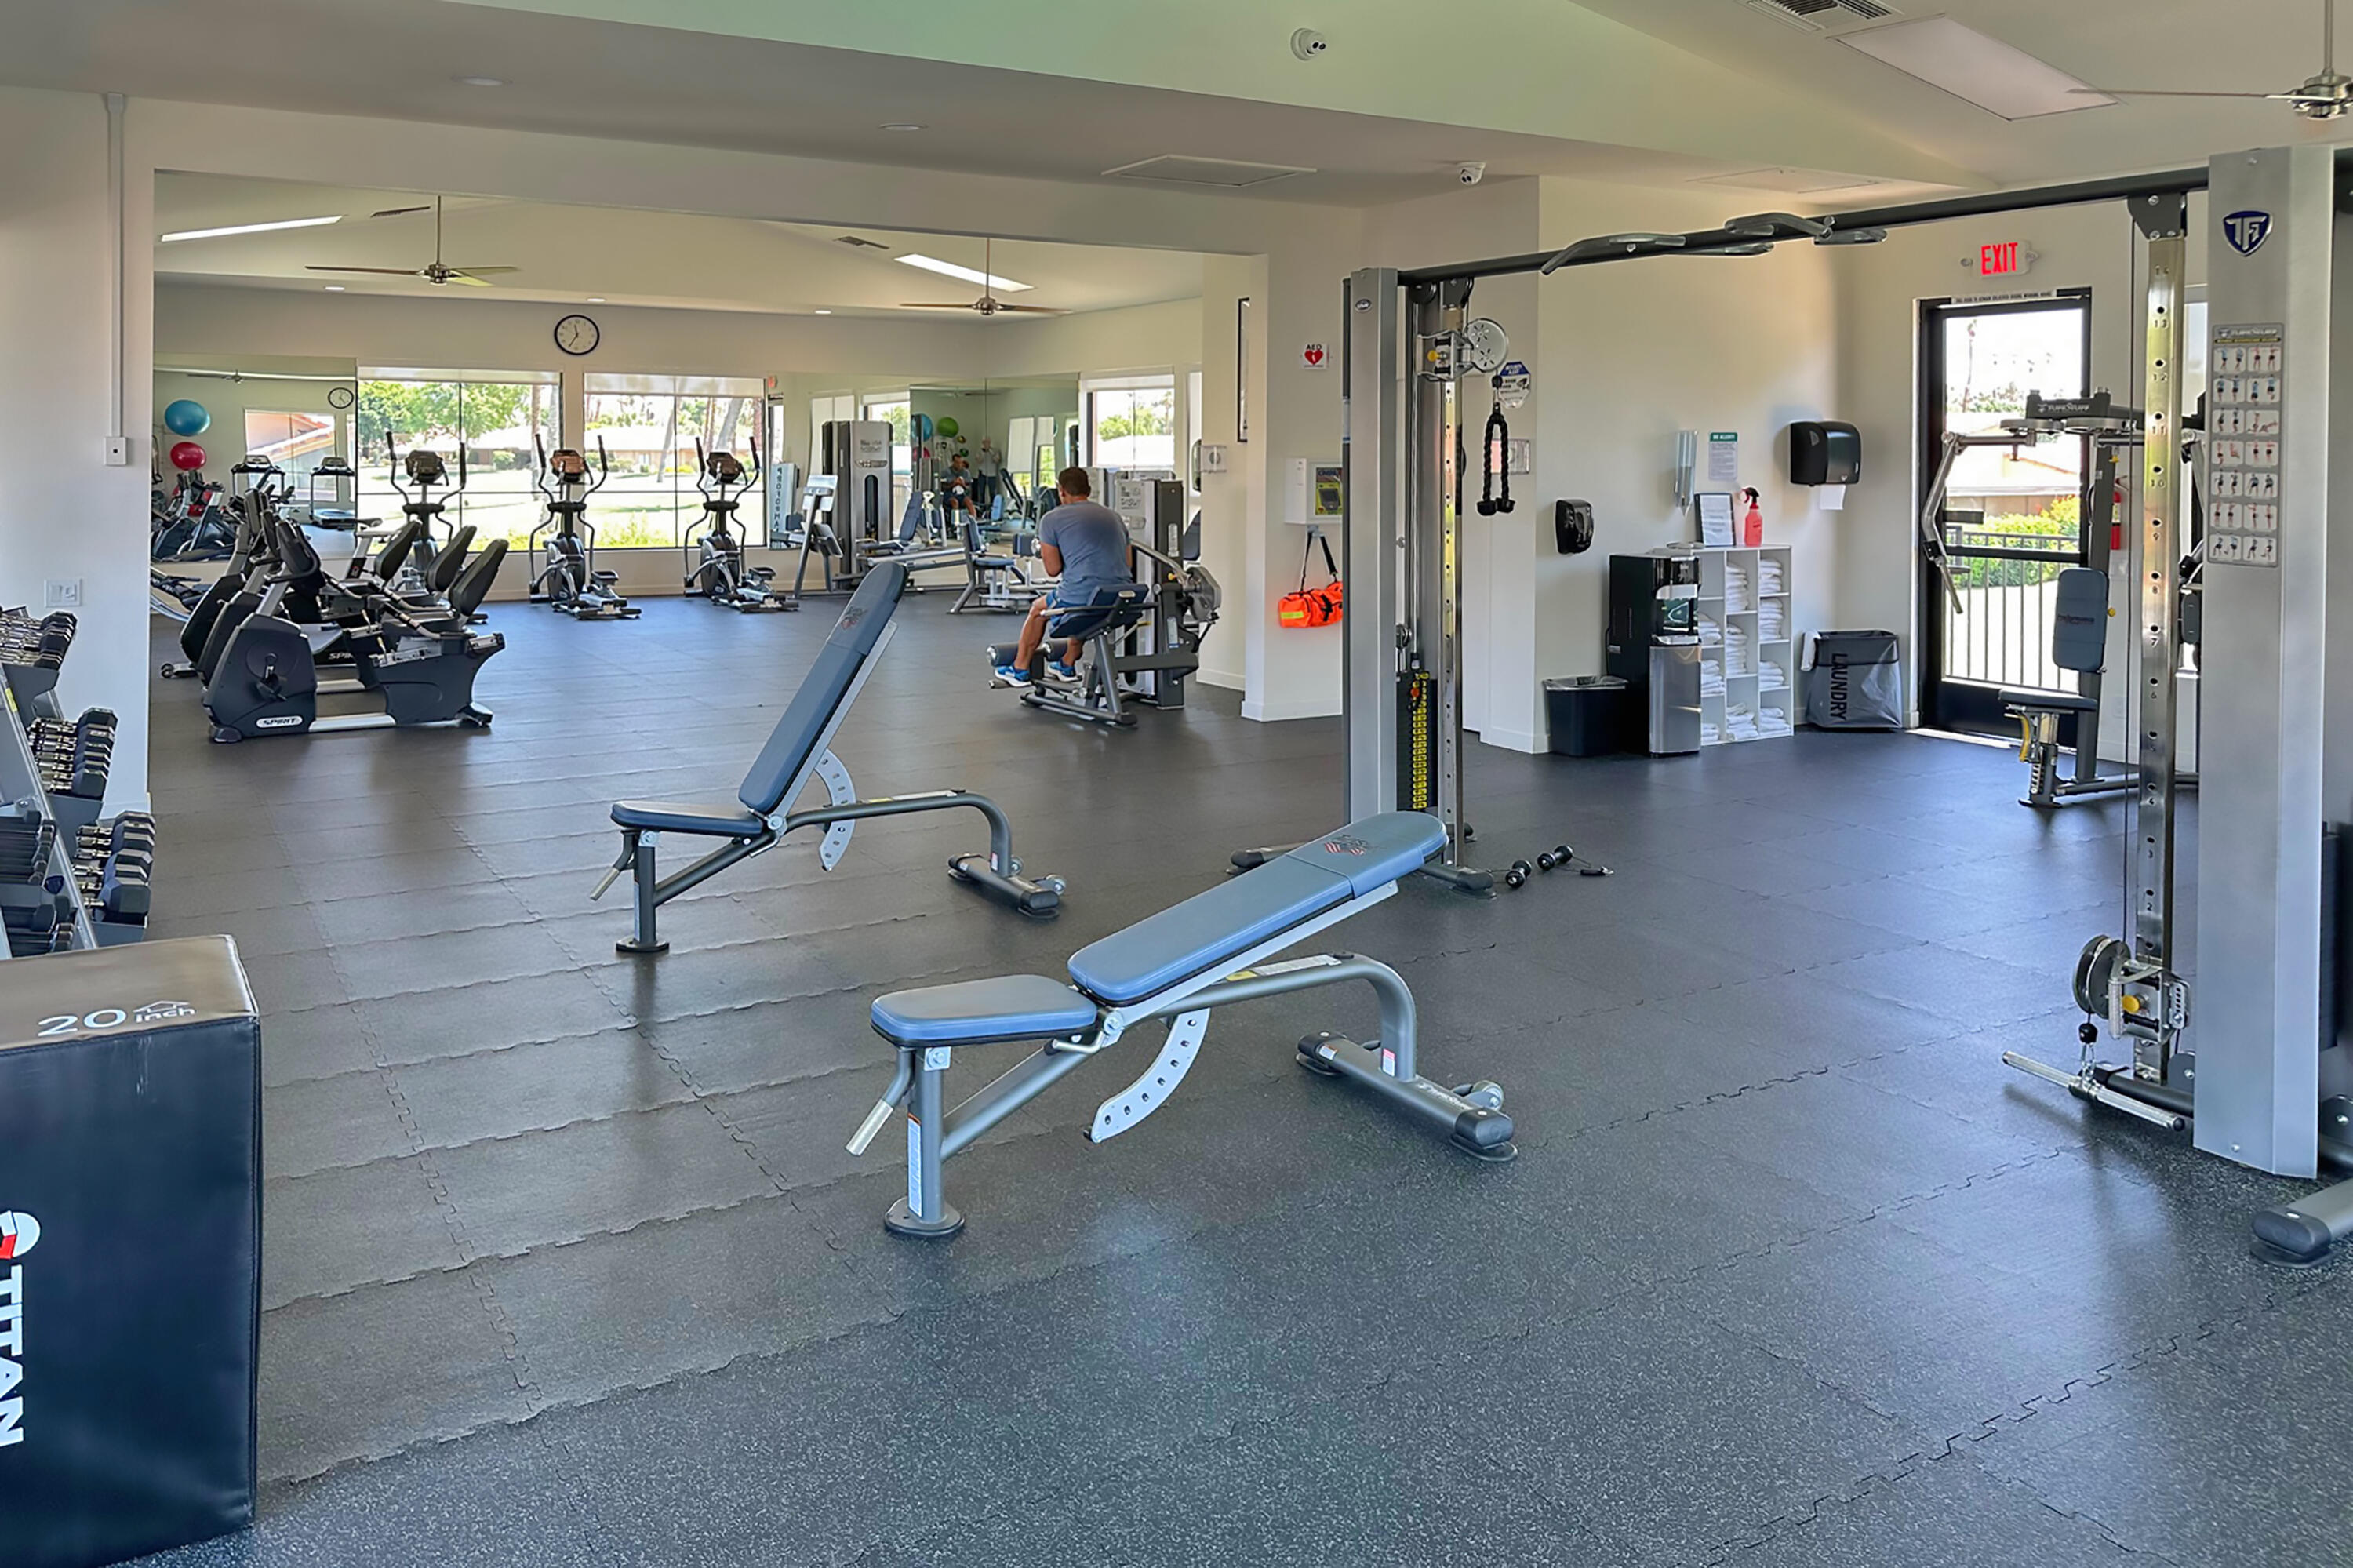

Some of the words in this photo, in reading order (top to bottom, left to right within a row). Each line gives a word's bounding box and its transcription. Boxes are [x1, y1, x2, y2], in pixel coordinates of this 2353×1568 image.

[1980, 242, 2019, 275] EXIT
[2154, 319, 2168, 329] 13
[2152, 373, 2167, 382] 12
[2151, 426, 2166, 435] 11
[2151, 479, 2165, 488] 10
[2151, 638, 2158, 646] 7
[1830, 653, 1848, 721] LAUNDRY
[2147, 902, 2153, 911] 2
[37, 1009, 127, 1037] 20
